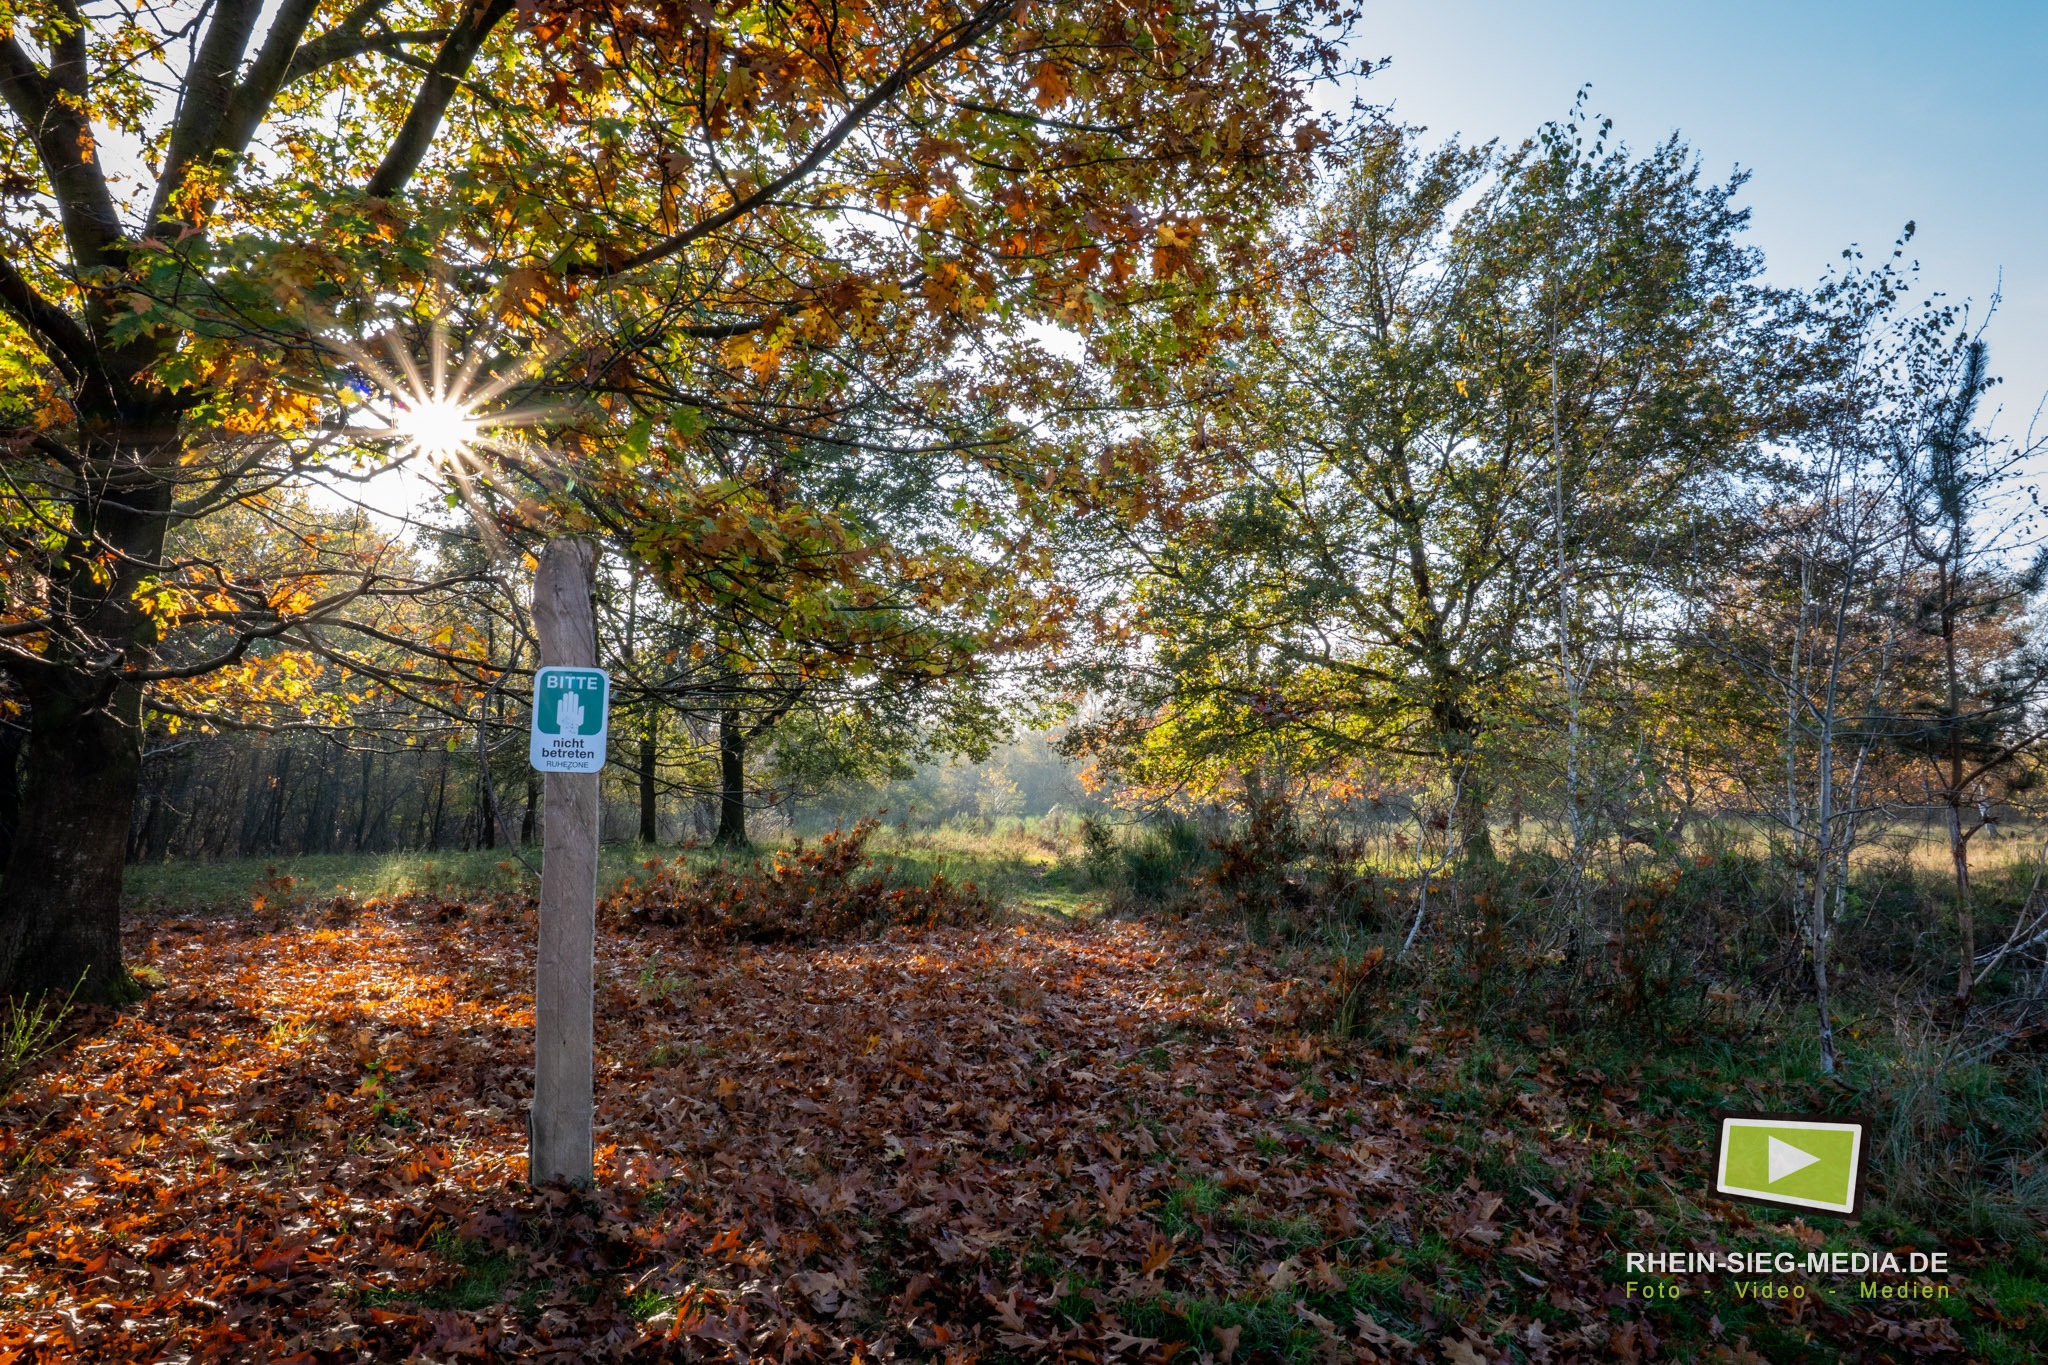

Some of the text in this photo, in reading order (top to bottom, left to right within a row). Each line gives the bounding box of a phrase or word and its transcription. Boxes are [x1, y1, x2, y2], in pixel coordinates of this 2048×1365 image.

[547, 675, 598, 690] BITTE
[553, 738, 584, 749] nicht
[542, 748, 594, 759] betreten
[546, 761, 589, 769] RUHEZONE
